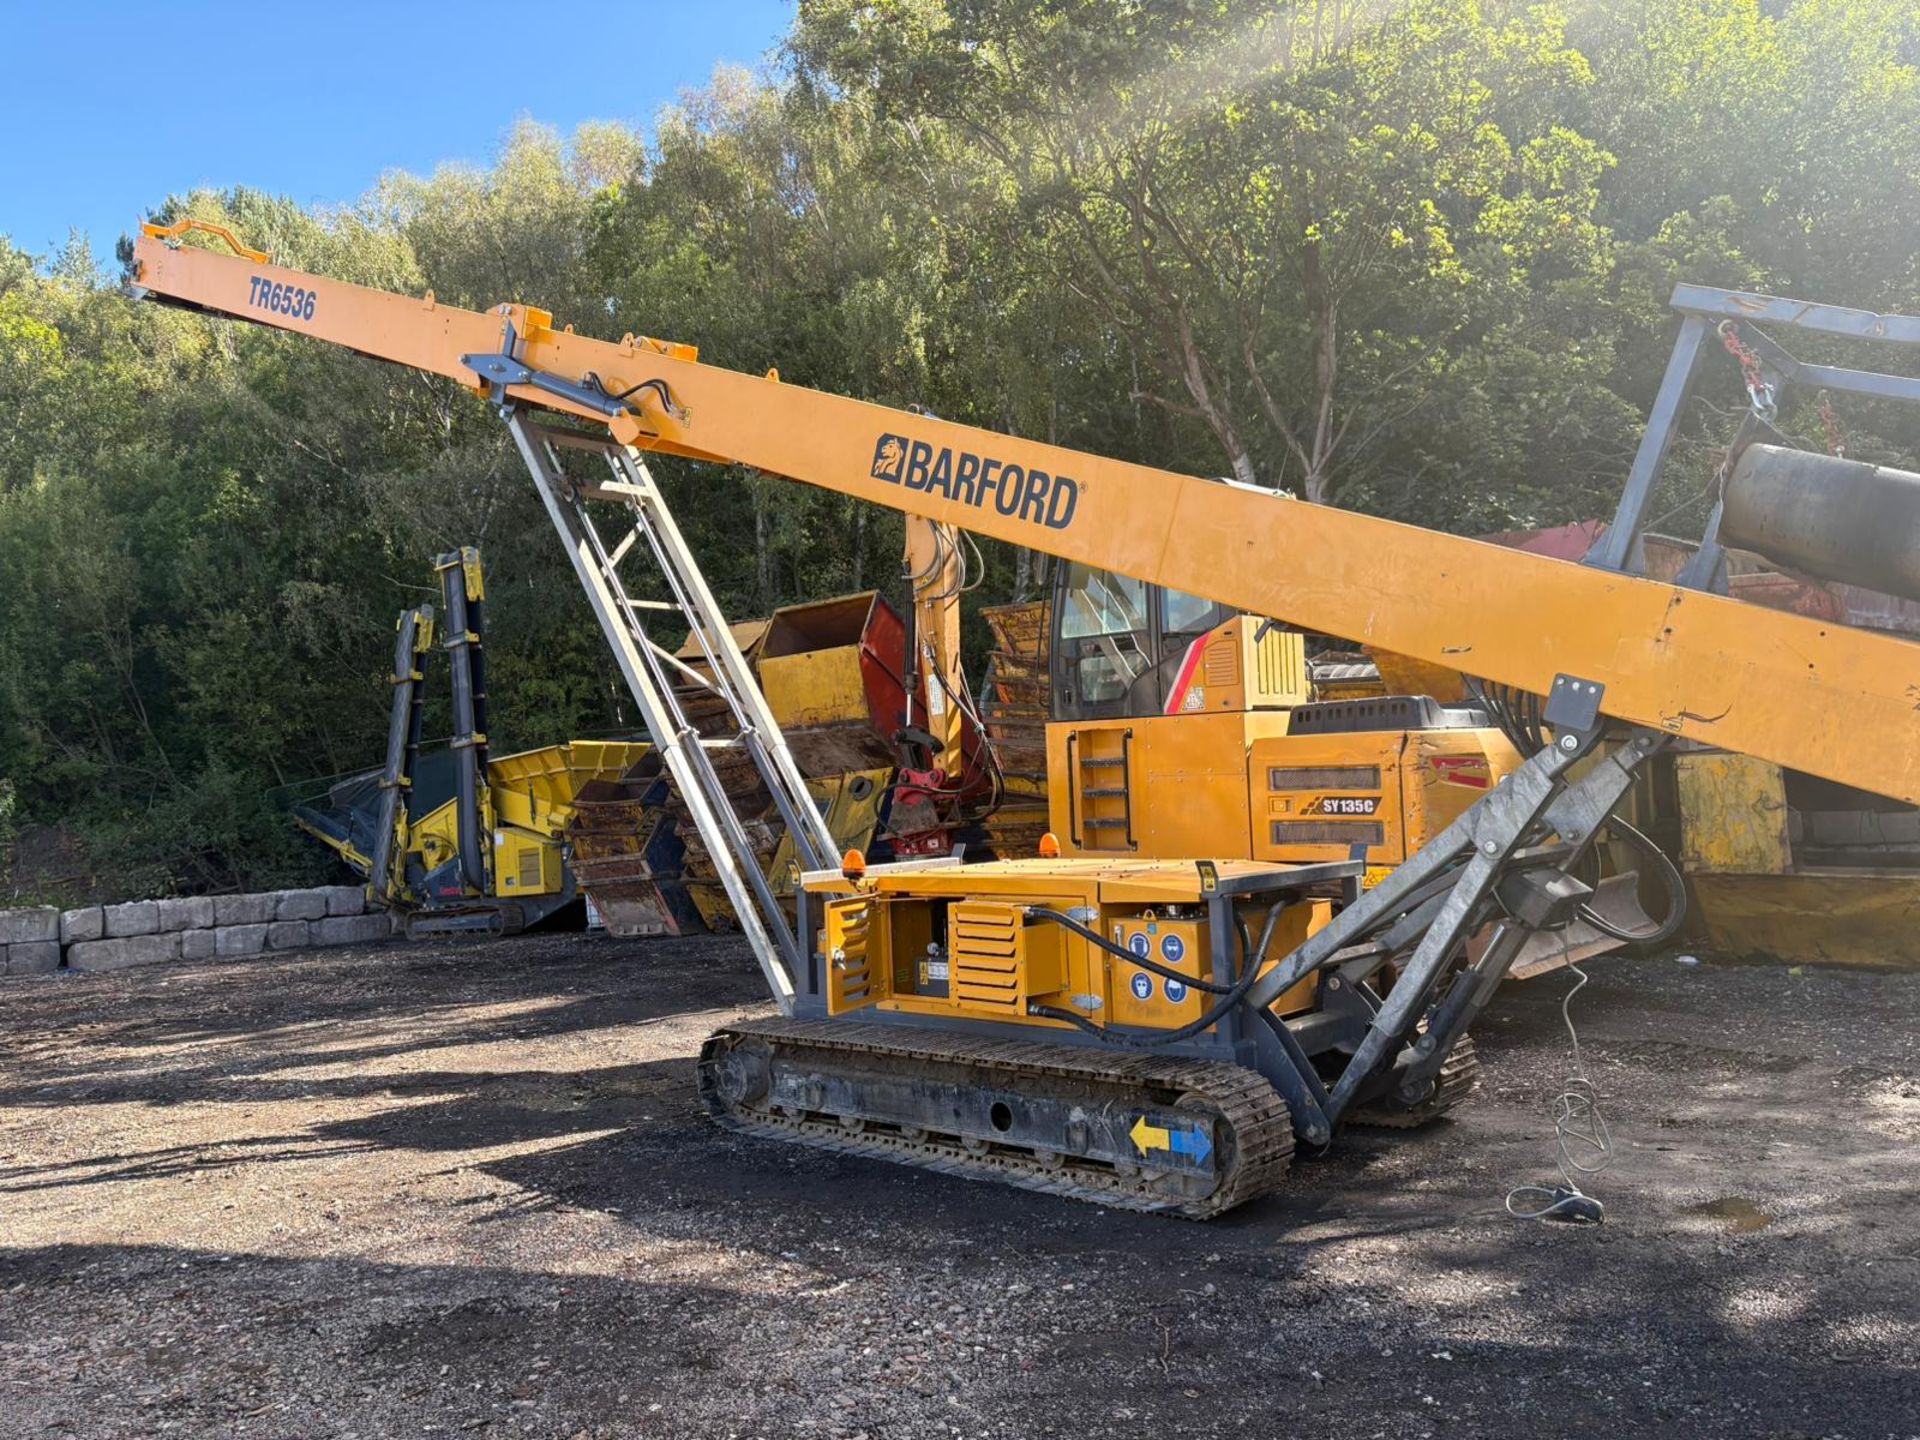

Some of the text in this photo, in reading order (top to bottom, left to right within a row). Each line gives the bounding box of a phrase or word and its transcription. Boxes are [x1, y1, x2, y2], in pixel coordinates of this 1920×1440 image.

[249, 275, 317, 321] TR6536
[904, 439, 1078, 529] BARFORD
[1323, 799, 1374, 813] SY135C
